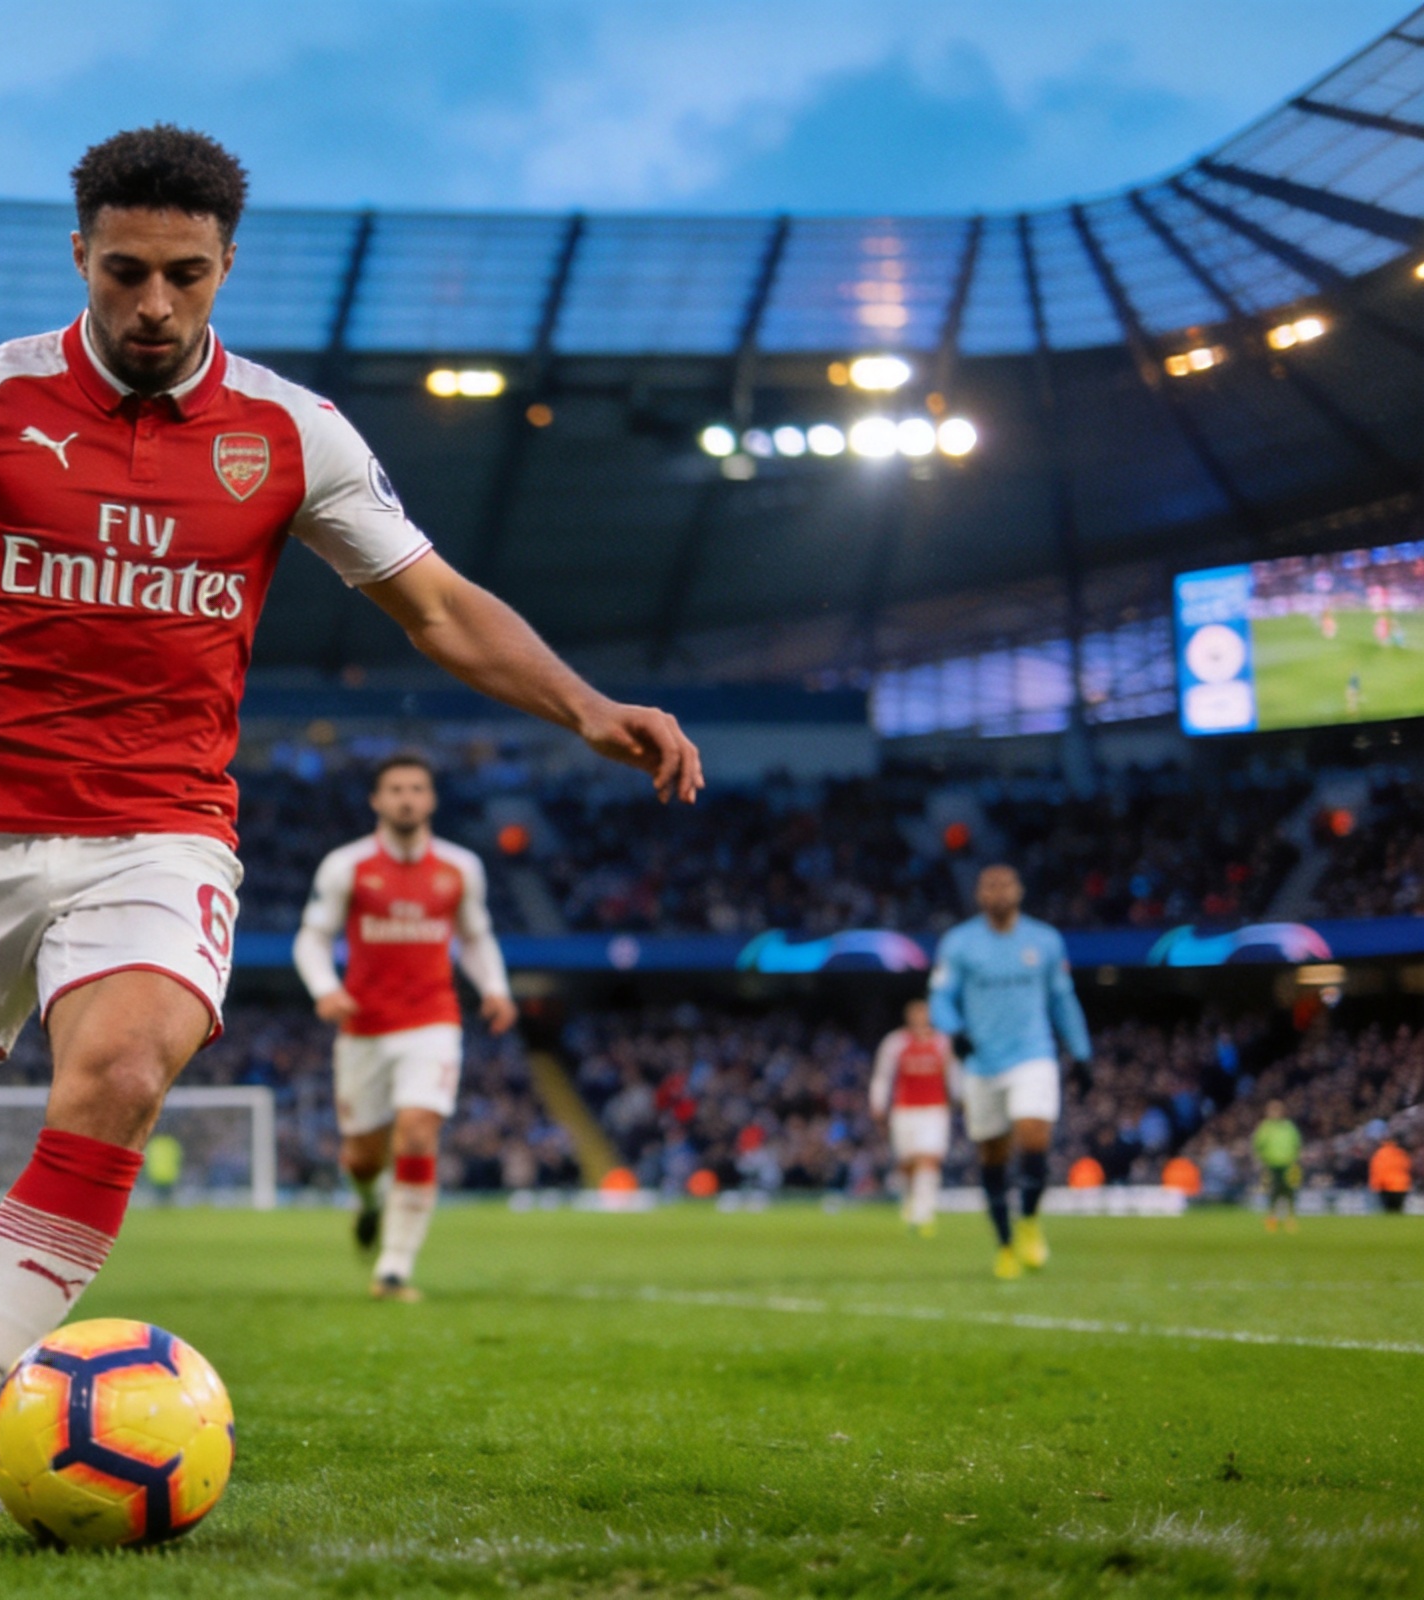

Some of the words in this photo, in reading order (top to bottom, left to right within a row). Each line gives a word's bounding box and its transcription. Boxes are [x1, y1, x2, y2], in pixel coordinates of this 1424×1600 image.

[99, 503, 176, 558] Fly
[1, 534, 246, 620] Emirates
[196, 883, 235, 958] 6
